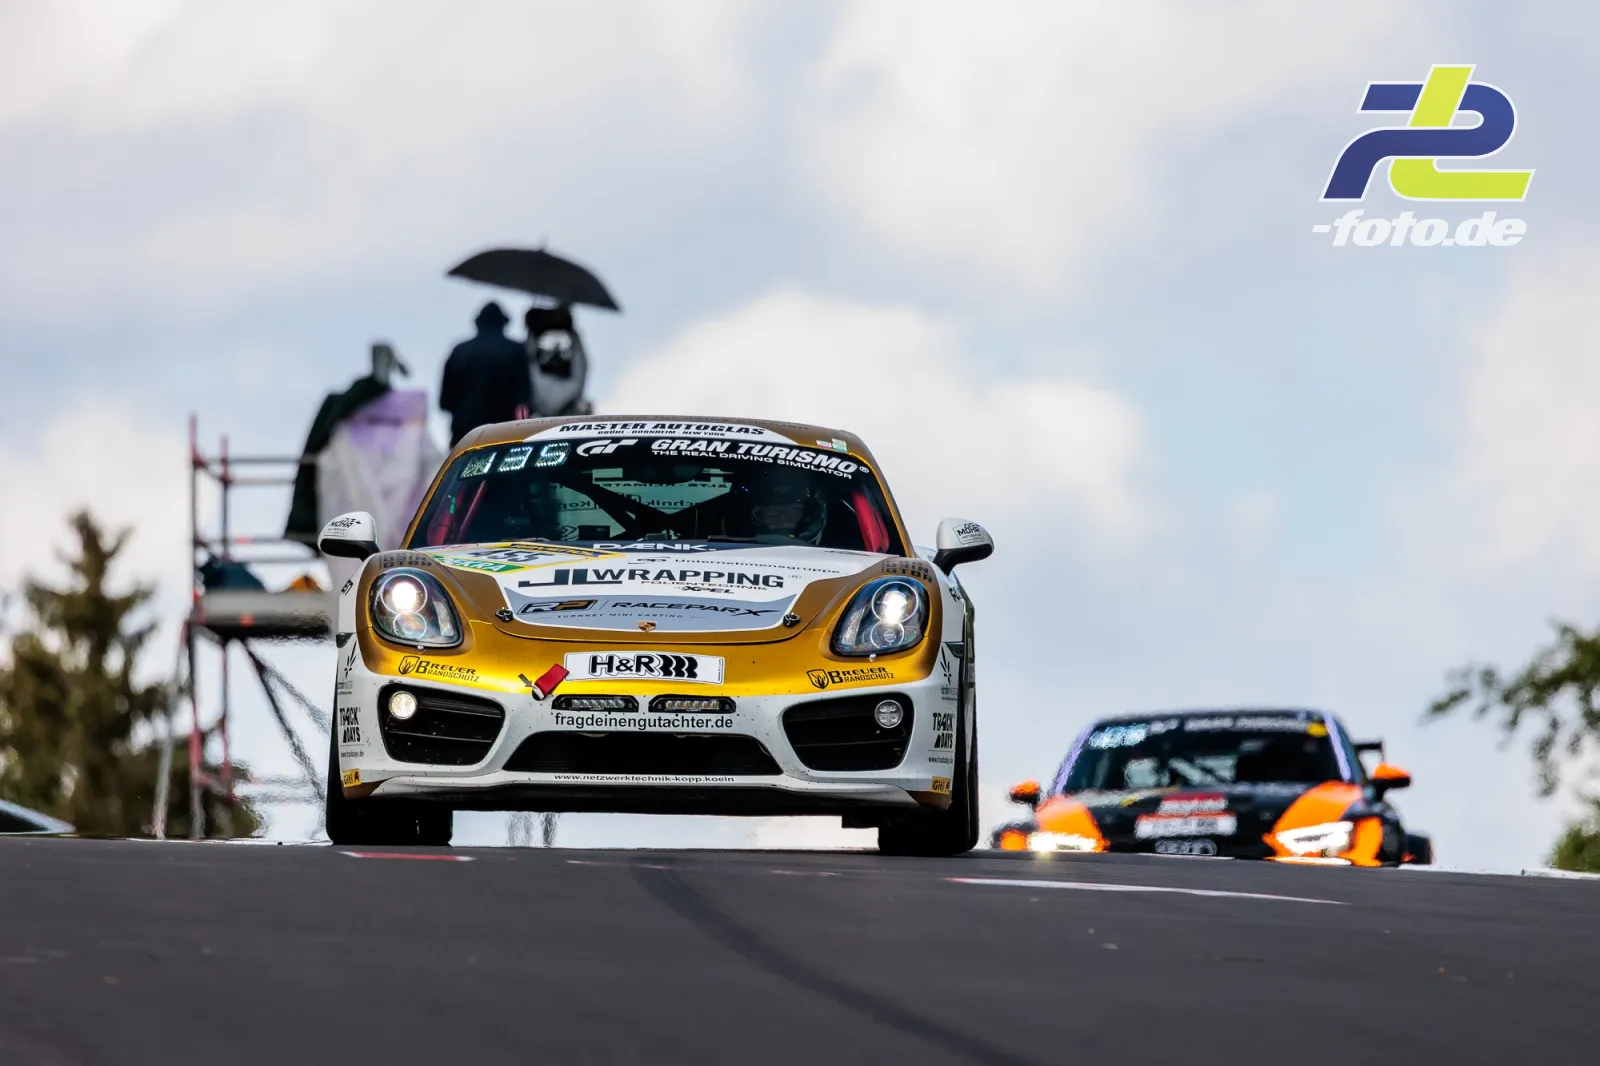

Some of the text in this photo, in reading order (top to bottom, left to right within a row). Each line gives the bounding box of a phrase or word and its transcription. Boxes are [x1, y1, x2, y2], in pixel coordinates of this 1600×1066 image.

[559, 422, 647, 433] MASTER
[653, 421, 766, 435] AUTOGLAS
[651, 438, 858, 474] GRAN TURISMO
[681, 449, 717, 458] REAL
[719, 452, 774, 464] DRIVING
[776, 458, 853, 480] SIMULATOR
[640, 580, 768, 591] FOLIENTECHNIK
[681, 585, 735, 595] XPEL
[415, 656, 477, 675] BREUER
[589, 654, 660, 677] H&R
[827, 666, 888, 684] BREUER
[554, 712, 734, 730] fragdeinengutachter.de
[554, 774, 735, 783] www.netzwerktechnik-kopp.koeln
